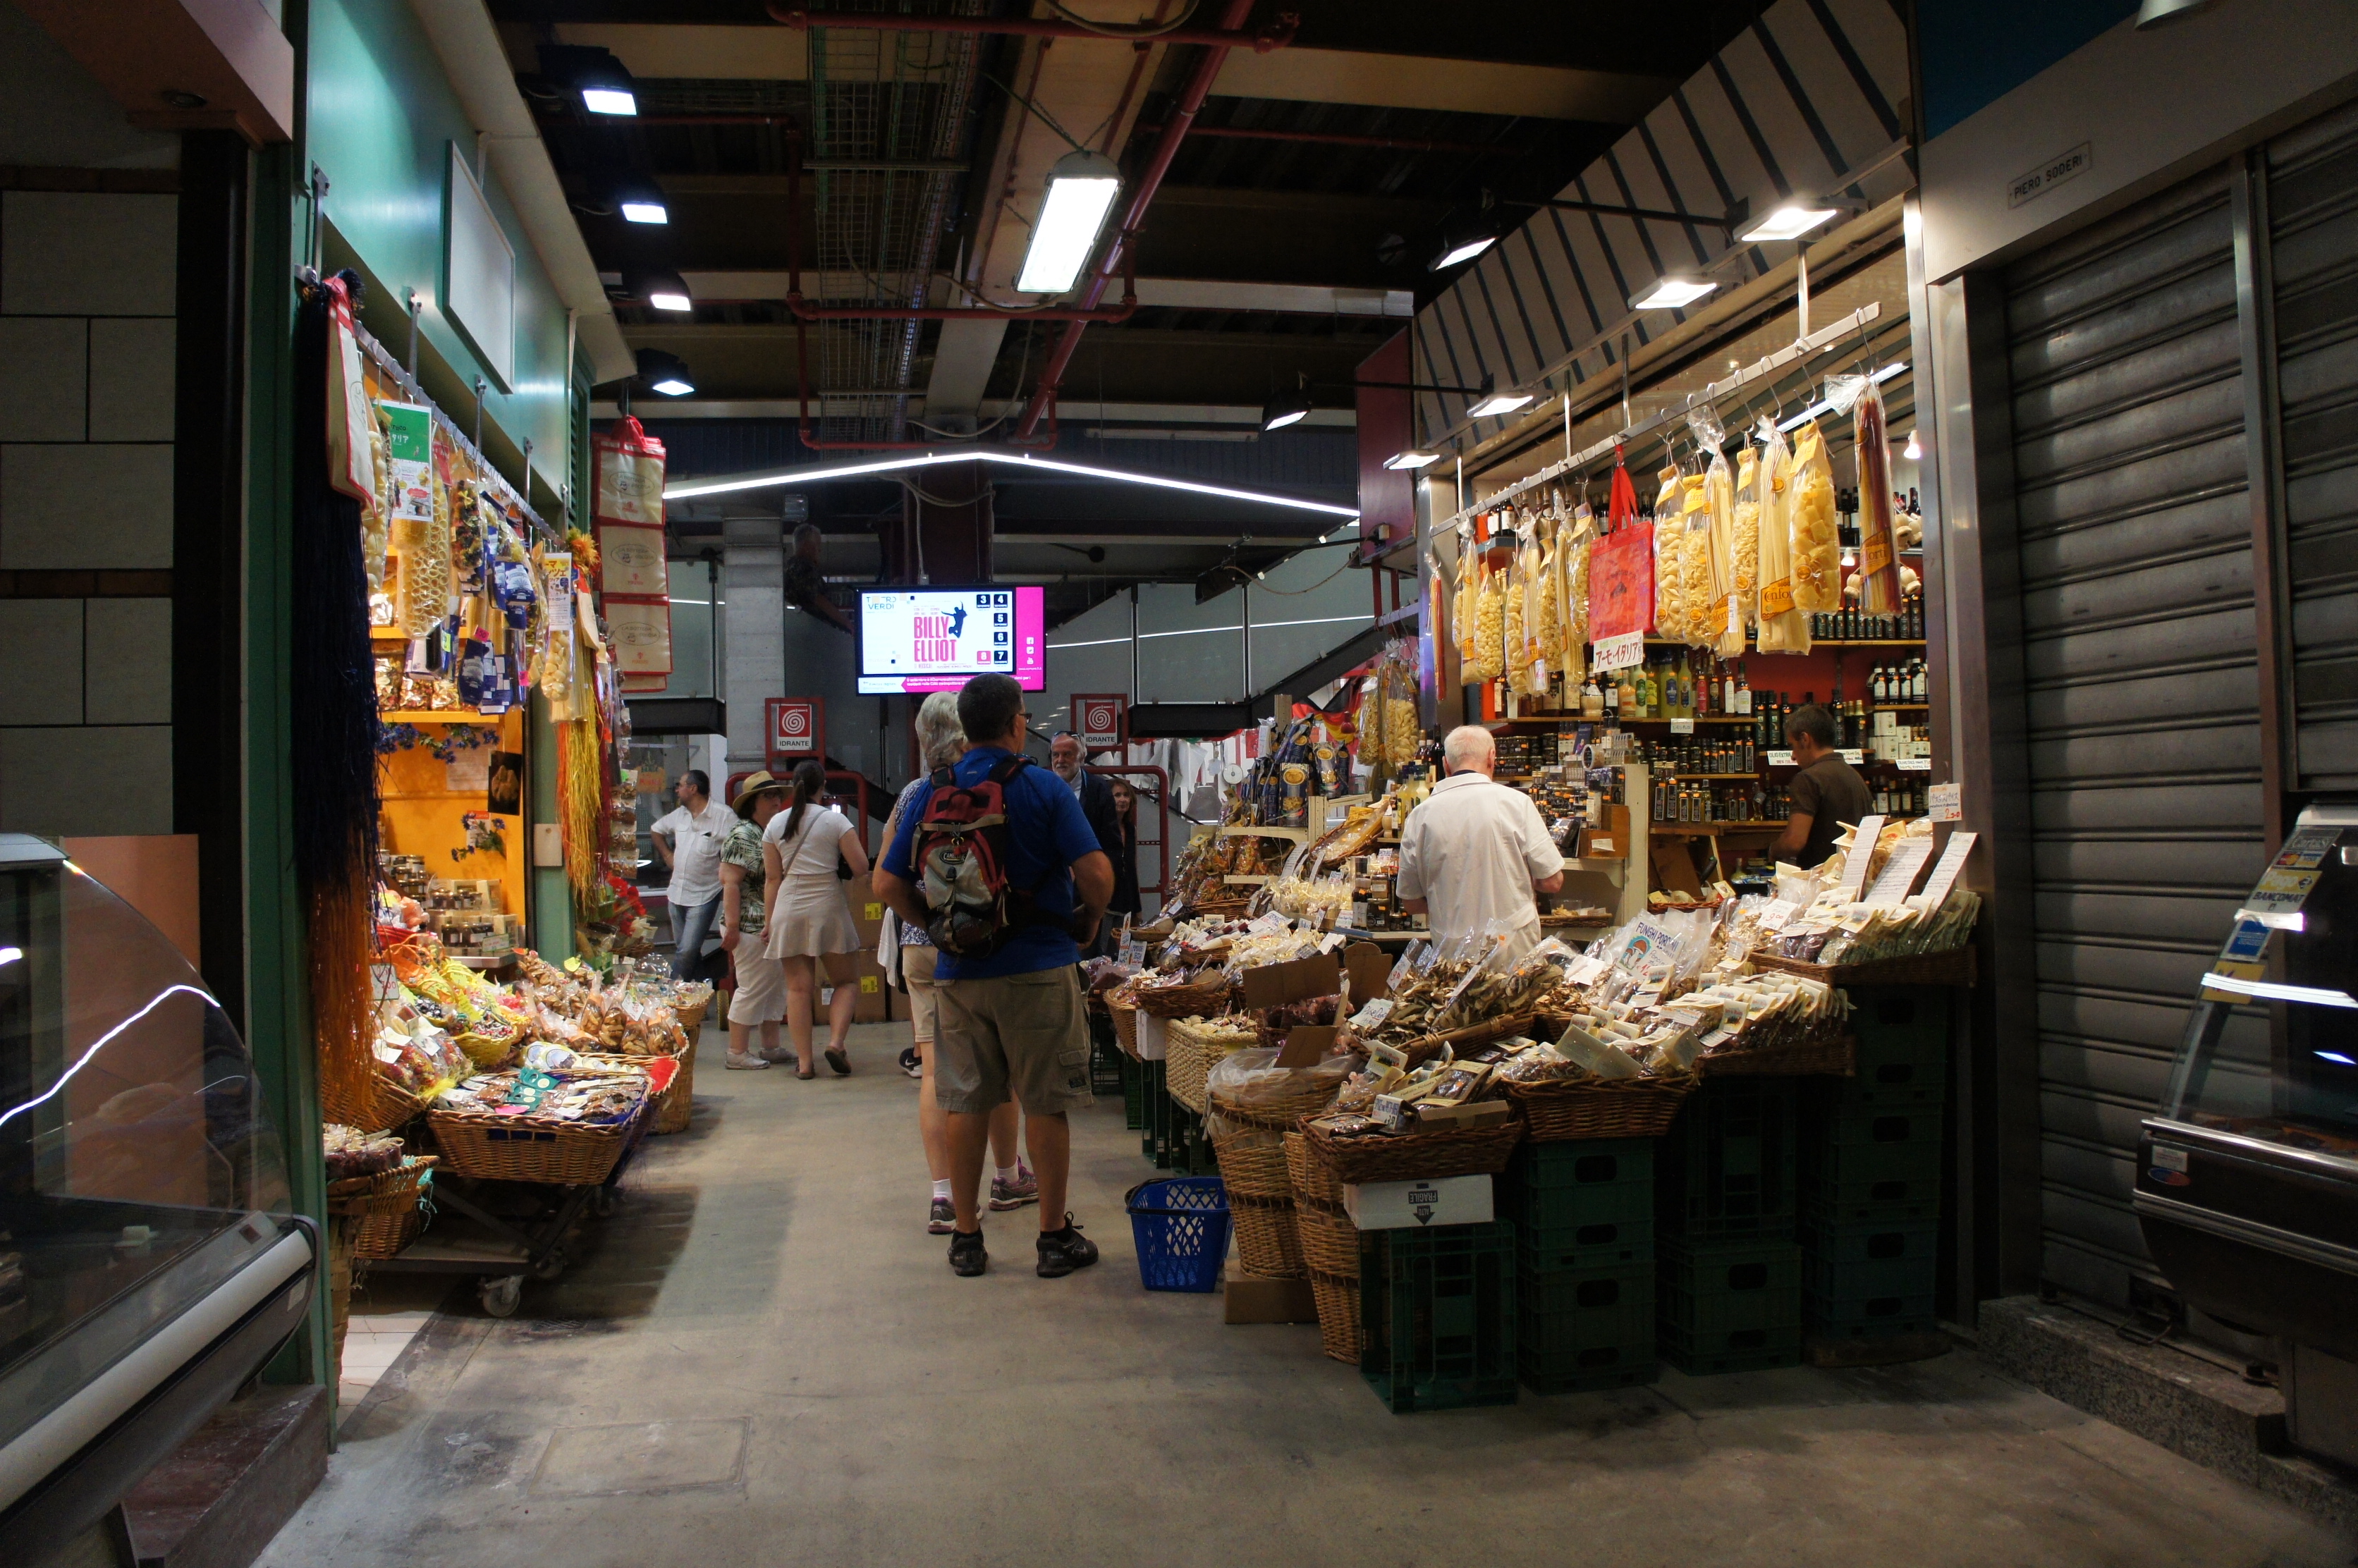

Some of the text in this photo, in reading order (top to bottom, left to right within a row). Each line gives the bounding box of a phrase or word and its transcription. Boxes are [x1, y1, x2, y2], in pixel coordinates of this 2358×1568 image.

[2014, 155, 2082, 199] PIERO SODERI
[997, 595, 1004, 604] 4
[997, 614, 1004, 623] 5
[914, 616, 949, 639] BILLY
[997, 633, 1004, 642] 6
[914, 639, 957, 662] ELLIOT
[998, 651, 1004, 660] 7
[980, 652, 987, 661] 8
[2253, 891, 2306, 903] BANCOMAT
[1635, 921, 1657, 941] FUNGHI
[1410, 1192, 1436, 1203] FRAGILE
[1418, 1208, 1429, 1216] ALTO
